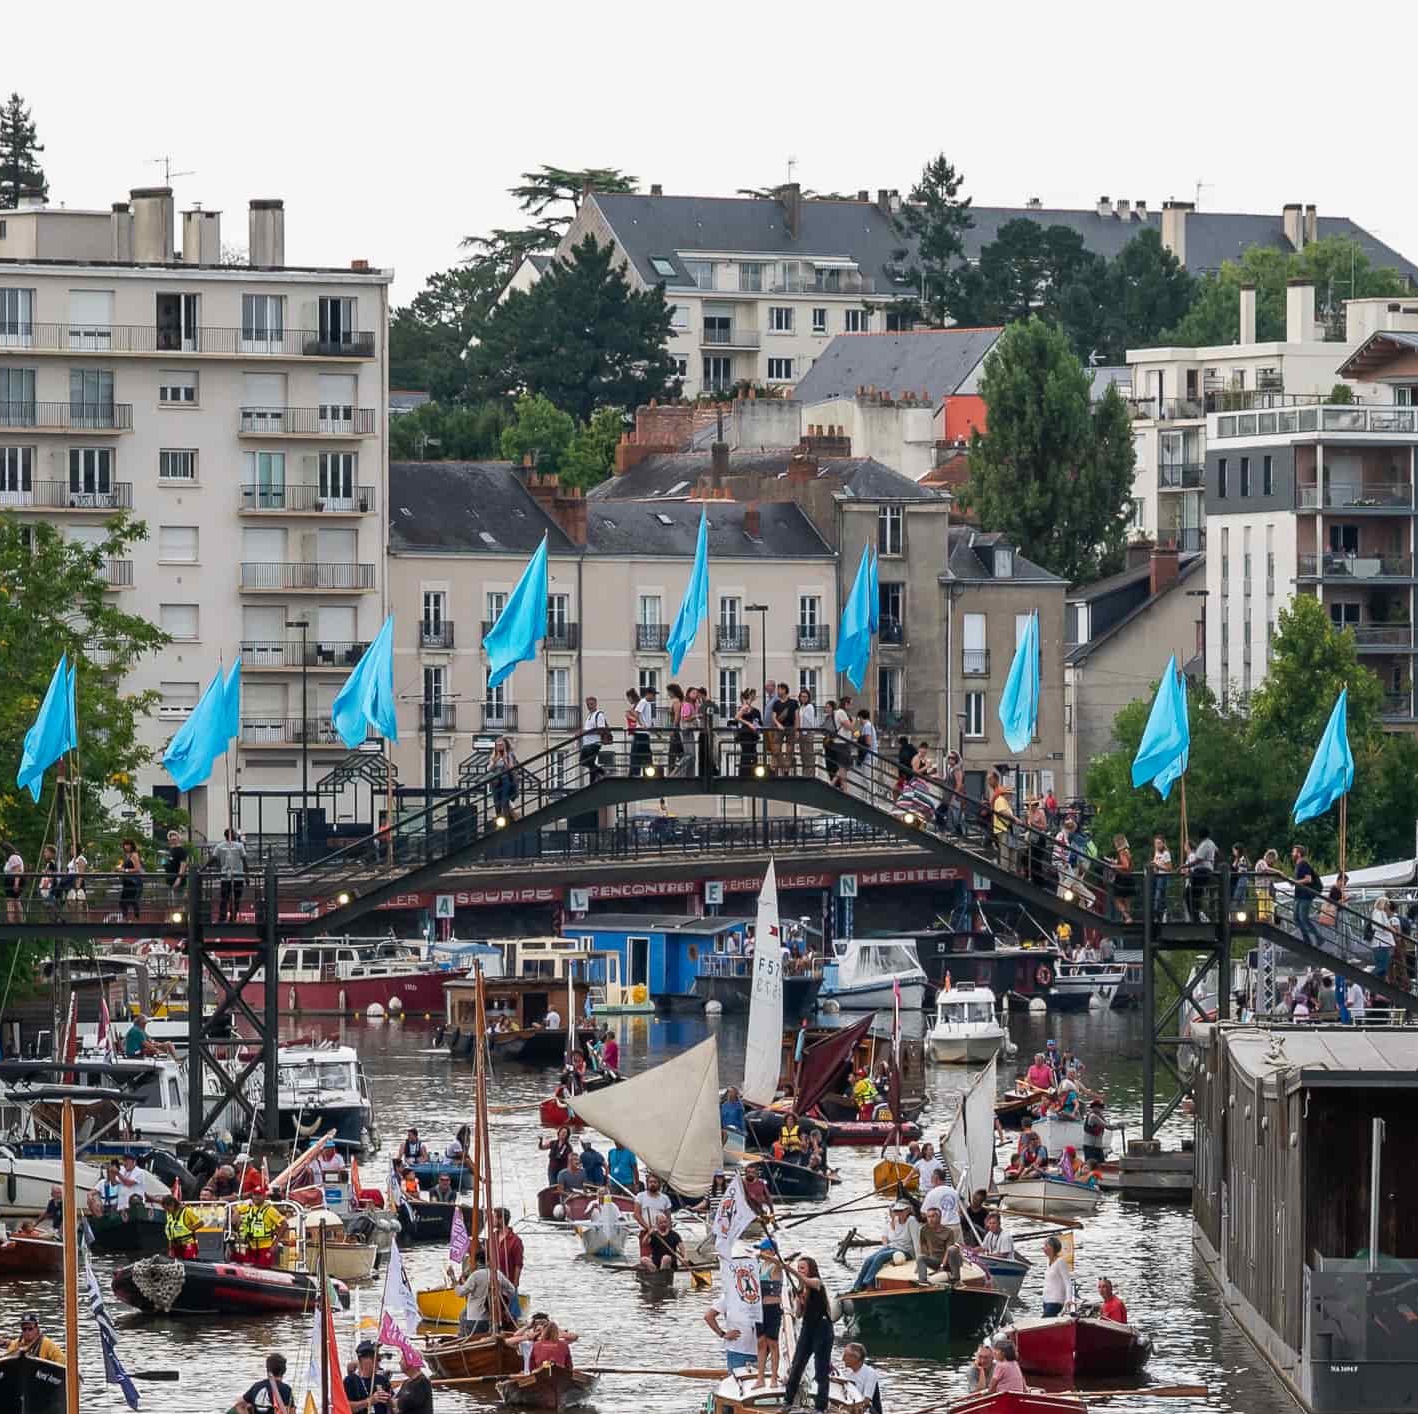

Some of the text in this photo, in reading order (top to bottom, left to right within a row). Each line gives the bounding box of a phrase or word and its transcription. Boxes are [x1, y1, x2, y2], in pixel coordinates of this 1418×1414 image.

[589, 881, 695, 897] RENCONTRER
[842, 875, 855, 895] N
[454, 888, 554, 905] SOURIRE
[438, 897, 450, 915] A
